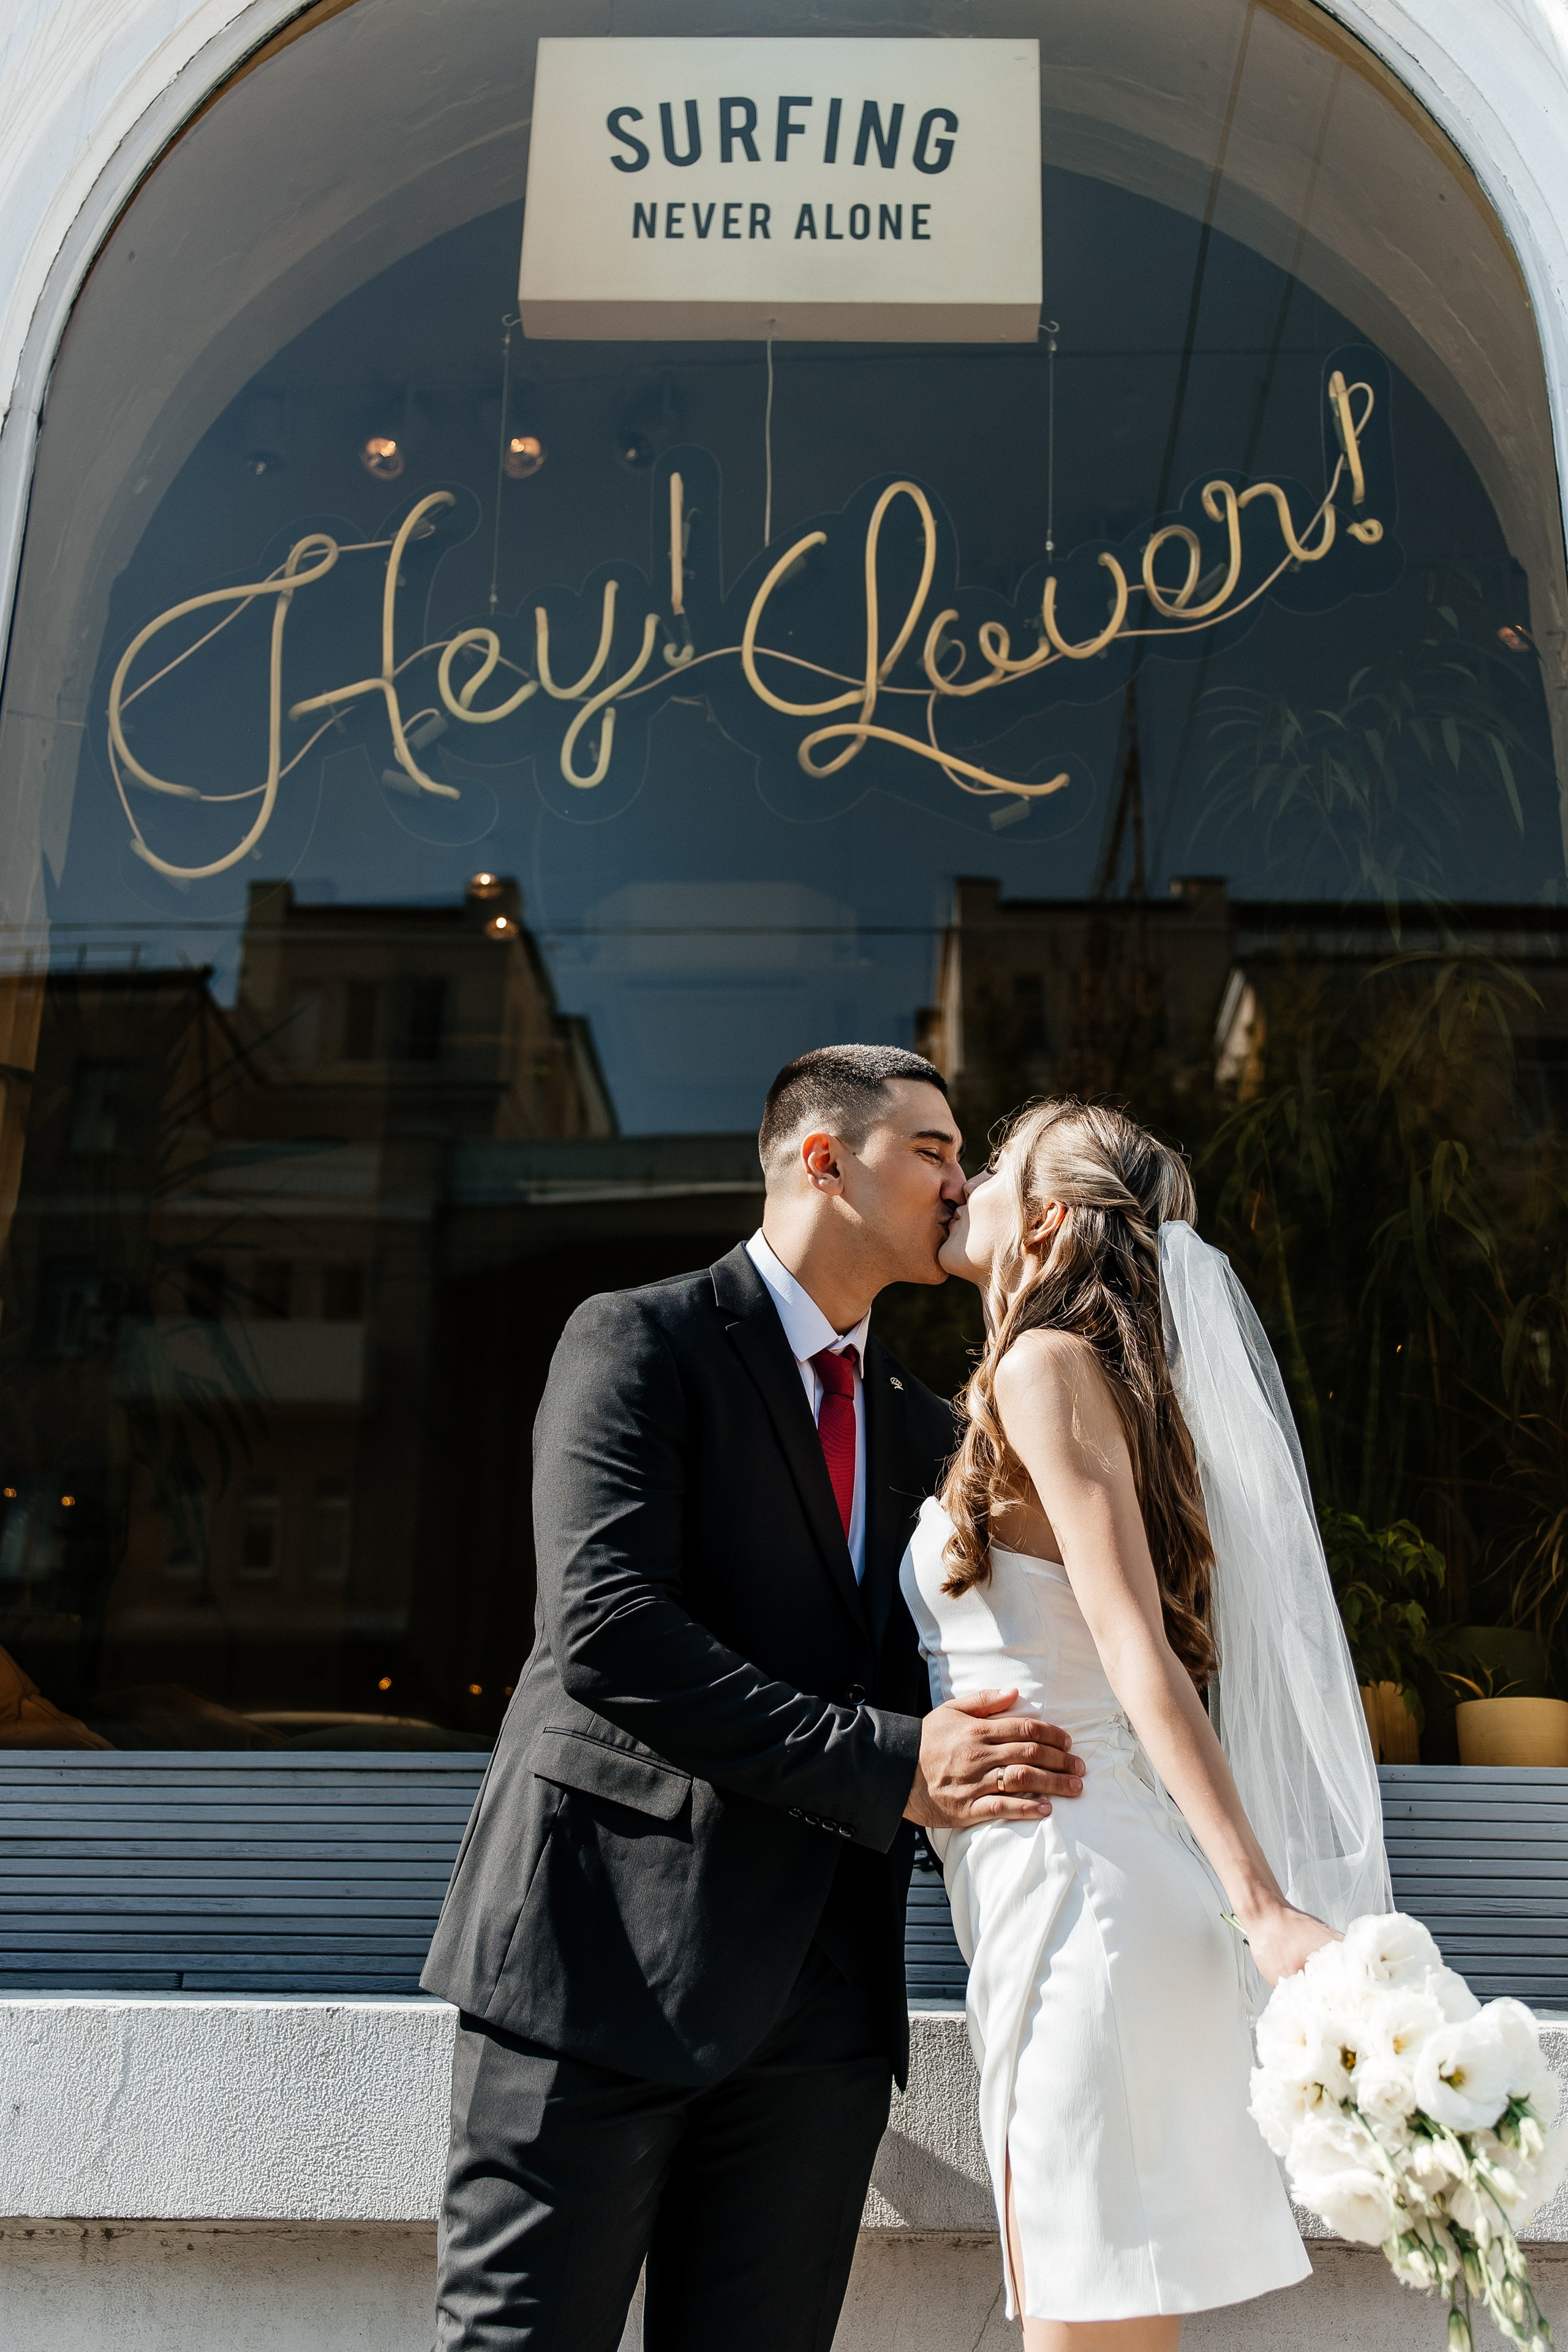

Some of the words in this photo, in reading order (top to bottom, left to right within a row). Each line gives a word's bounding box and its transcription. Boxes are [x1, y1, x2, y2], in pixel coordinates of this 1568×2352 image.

[606, 96, 959, 175] SURFING
[631, 202, 771, 239] NEVER
[794, 203, 932, 240] ALONE
[109, 472, 695, 880] Hey!
[742, 370, 1383, 796] Lover!
